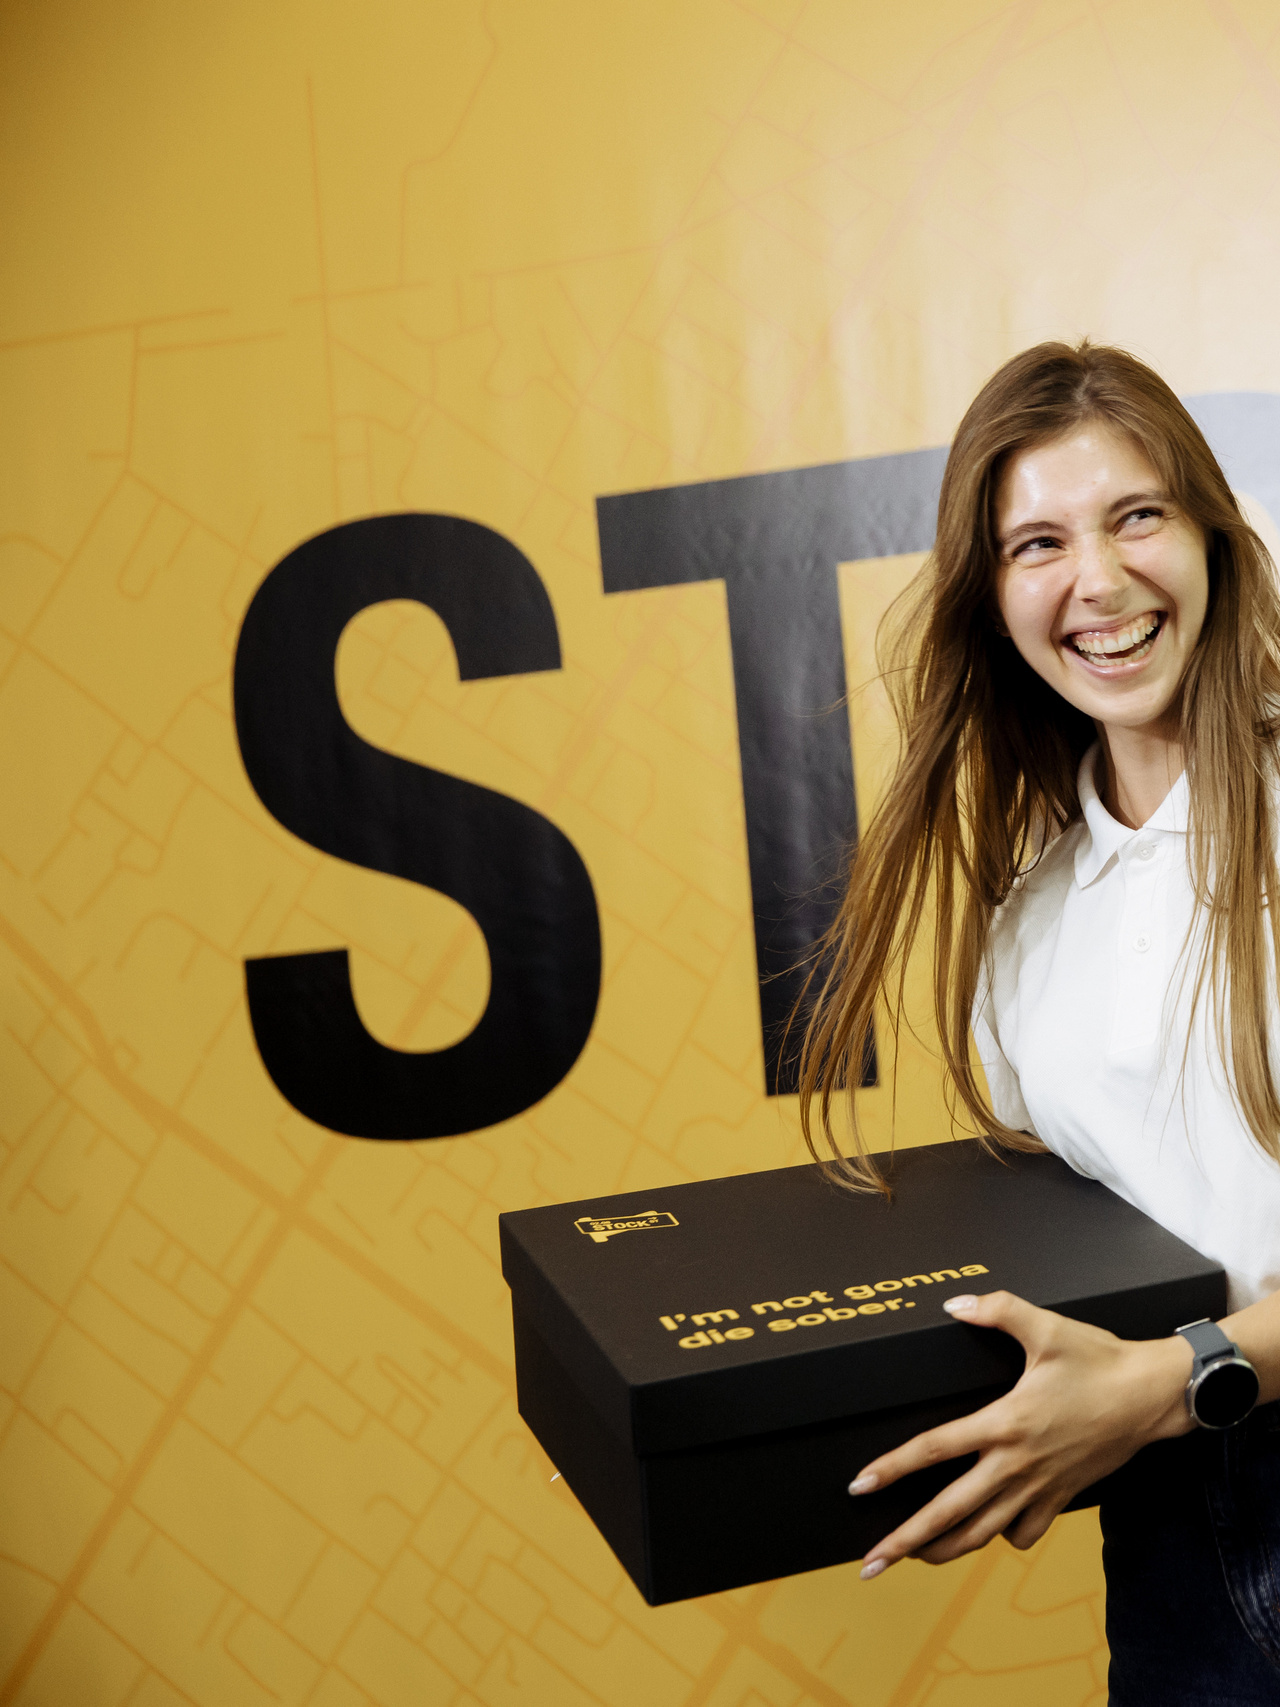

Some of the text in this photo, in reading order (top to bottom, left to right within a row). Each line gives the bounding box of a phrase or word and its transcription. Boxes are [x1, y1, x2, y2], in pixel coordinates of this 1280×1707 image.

[592, 1220, 651, 1231] STOCK
[659, 1263, 989, 1331] I'm not gonna
[679, 1298, 916, 1348] die sober.
